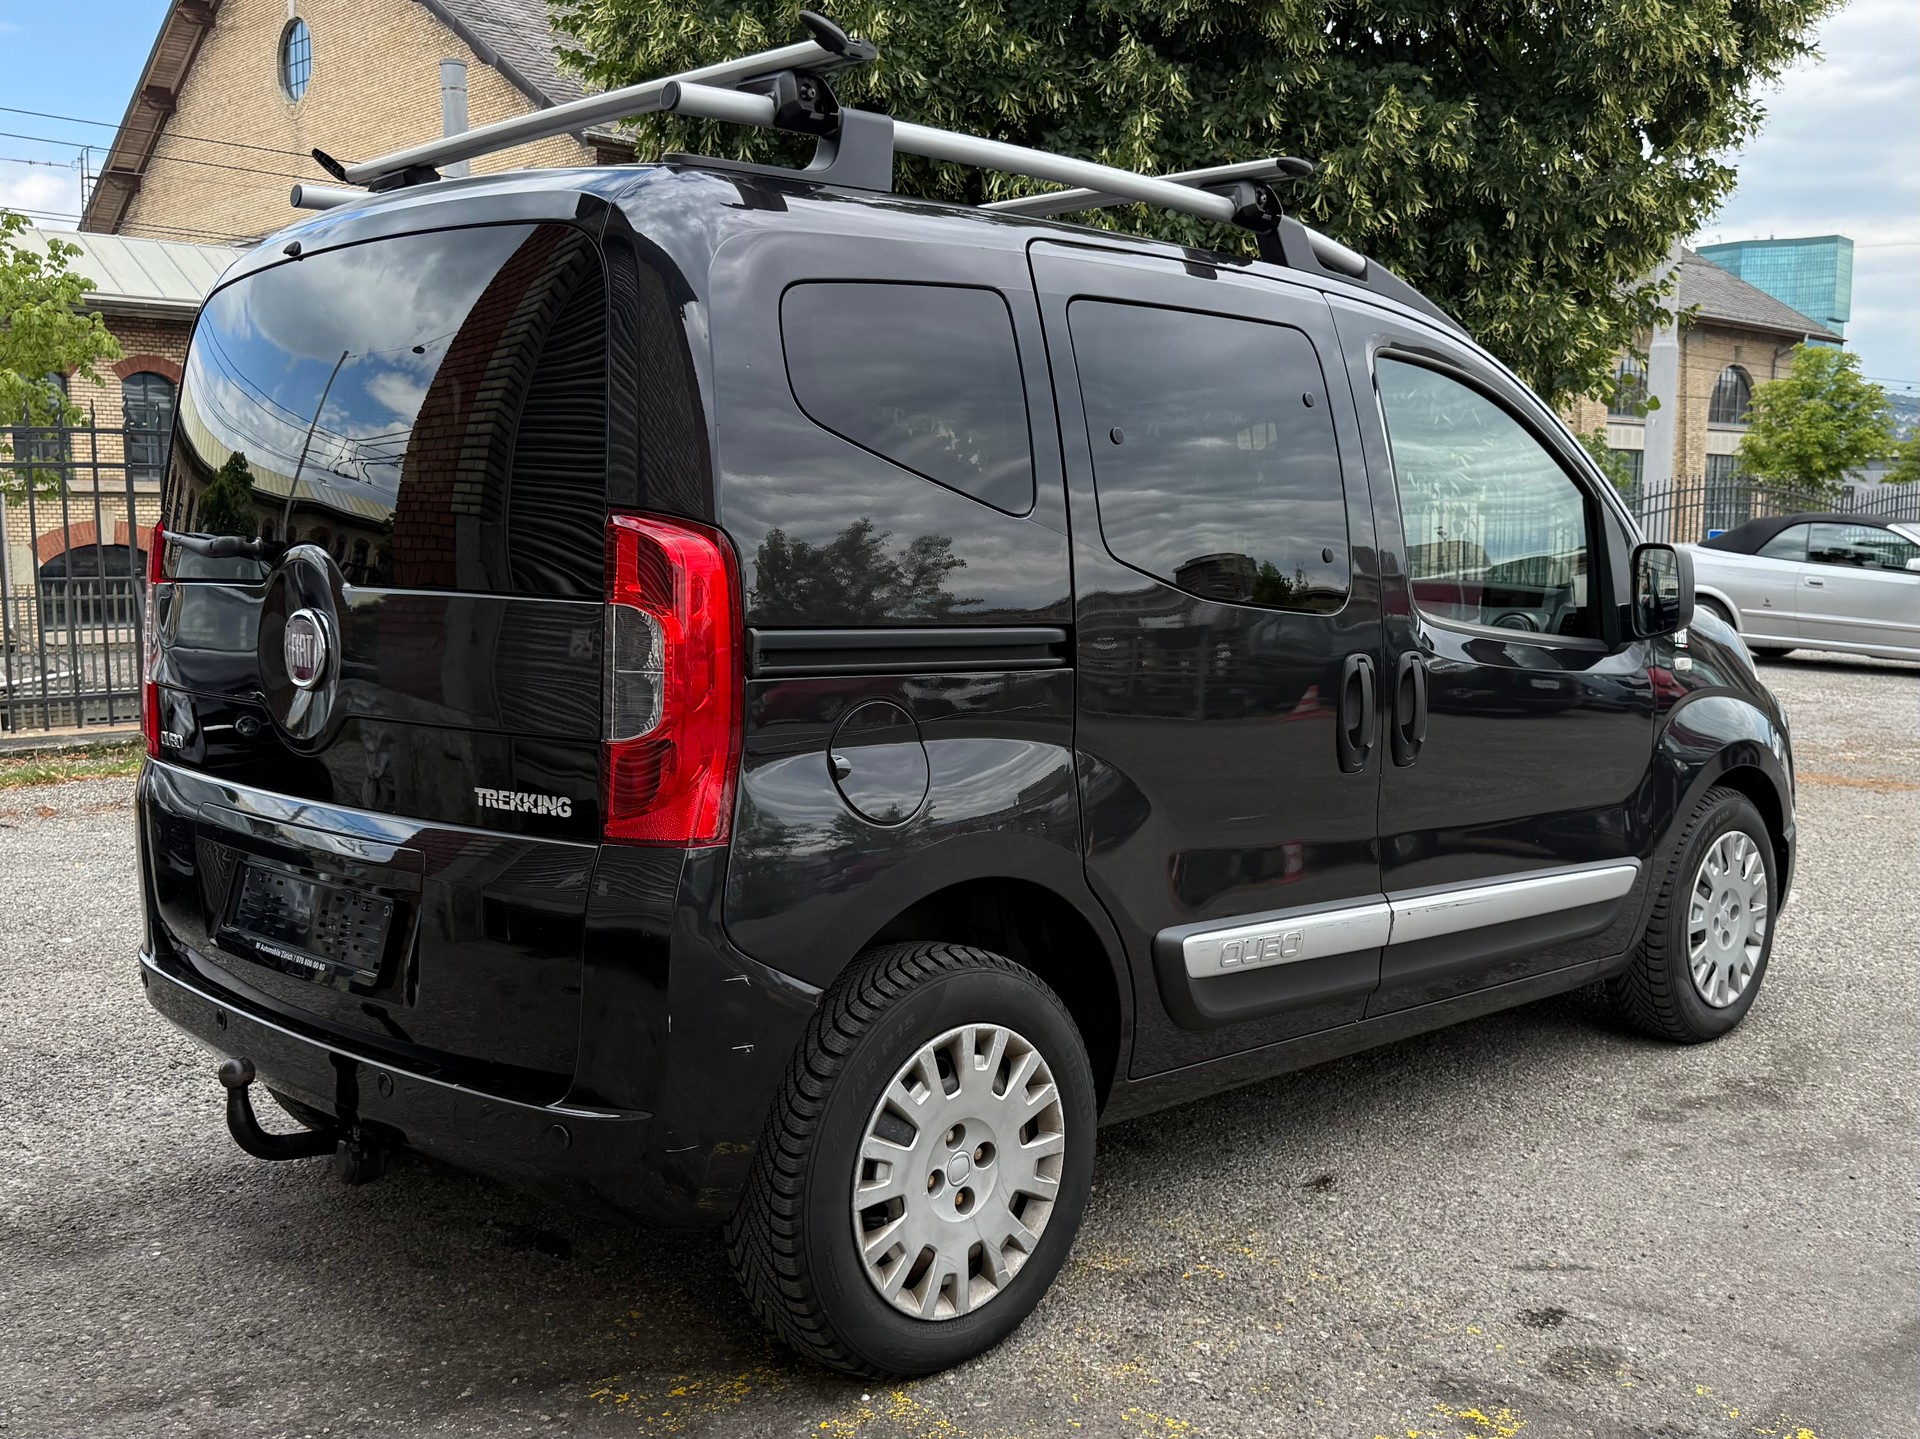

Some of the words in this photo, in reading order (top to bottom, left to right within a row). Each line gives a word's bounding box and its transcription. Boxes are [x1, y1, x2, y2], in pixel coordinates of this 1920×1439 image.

[291, 633, 314, 669] FIAT
[474, 787, 572, 818] TREKKING
[260, 944, 281, 957] Automobile
